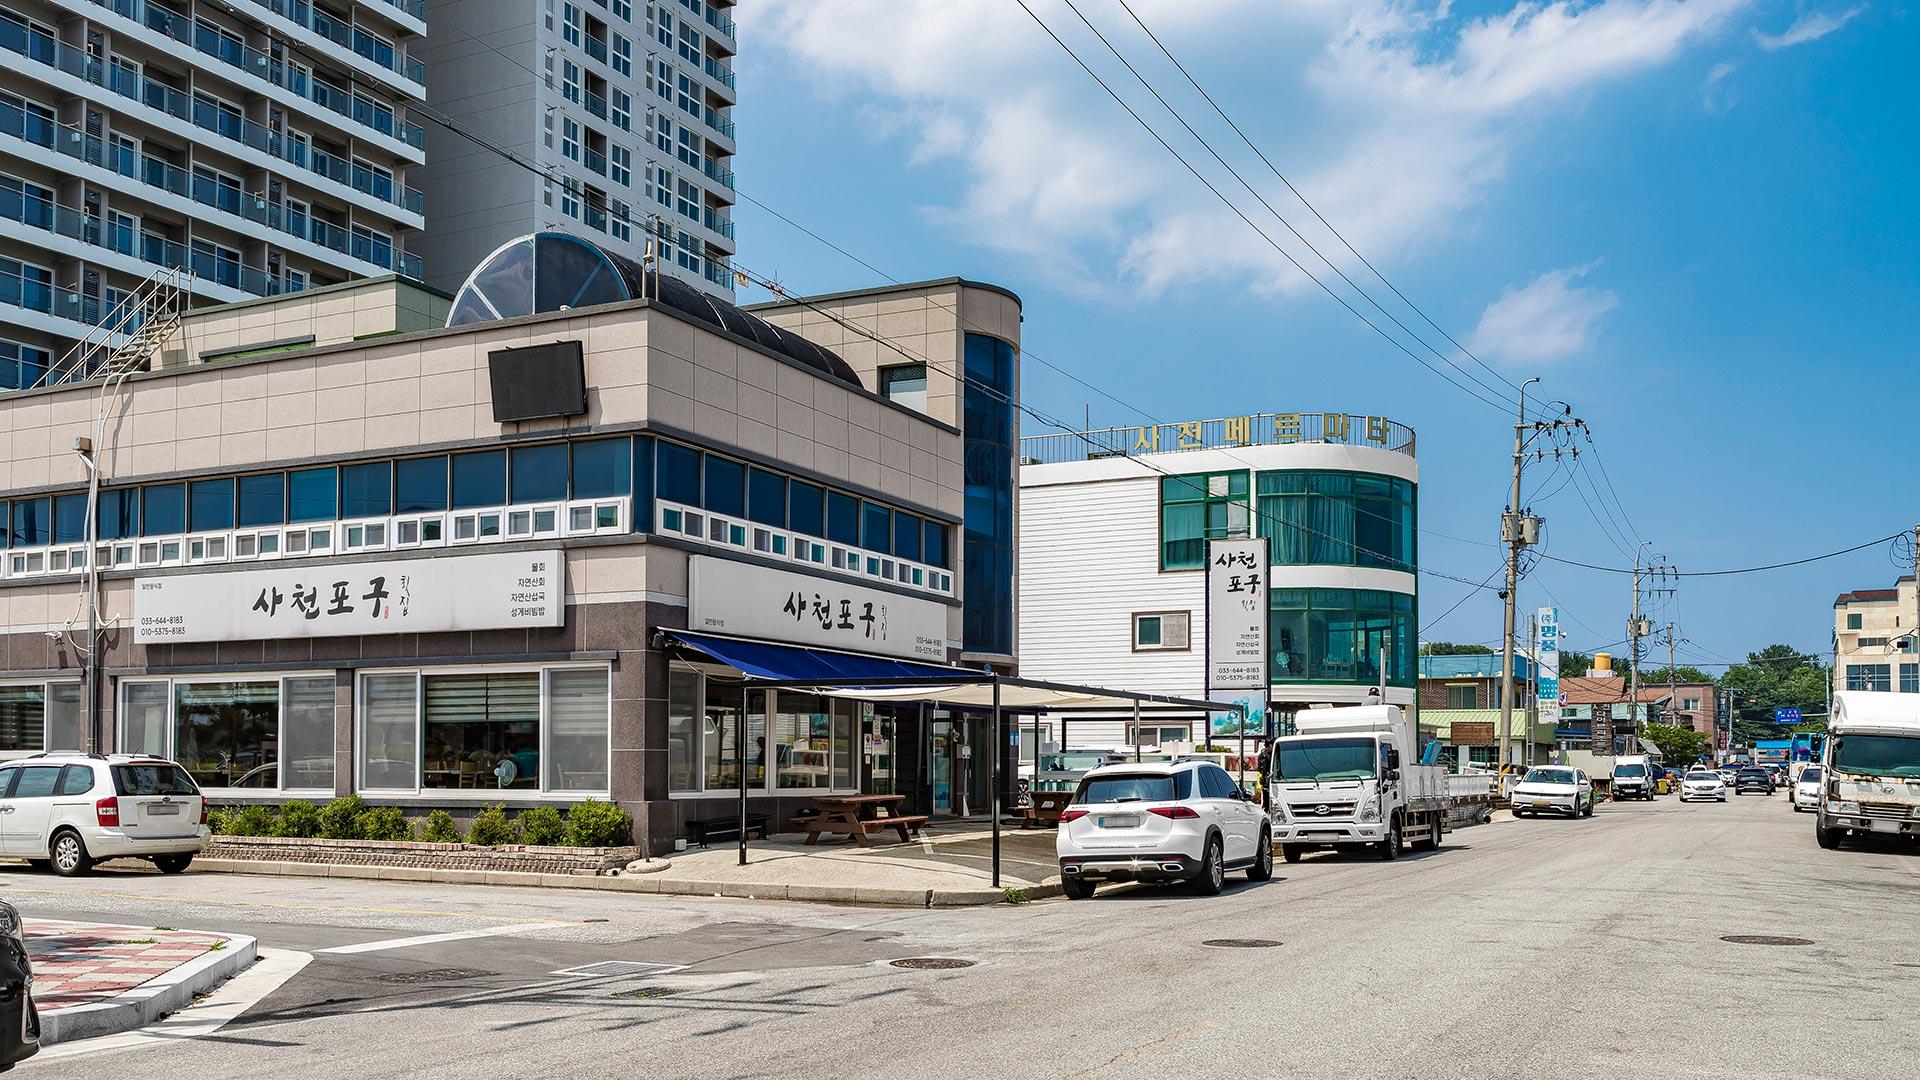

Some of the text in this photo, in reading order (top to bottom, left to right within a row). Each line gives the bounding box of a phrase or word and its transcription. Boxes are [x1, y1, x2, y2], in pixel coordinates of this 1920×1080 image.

[1215, 551, 1257, 569] 사천
[531, 562, 546, 572] 물회
[517, 577, 546, 587] 자연산회
[1227, 574, 1261, 594] 포구
[252, 576, 390, 620] 사천포구
[510, 591, 546, 602] 자연산섭국
[783, 591, 876, 639] 사천포구
[141, 616, 184, 626] 033-644-8183
[140, 627, 186, 636] 010-5375-8183
